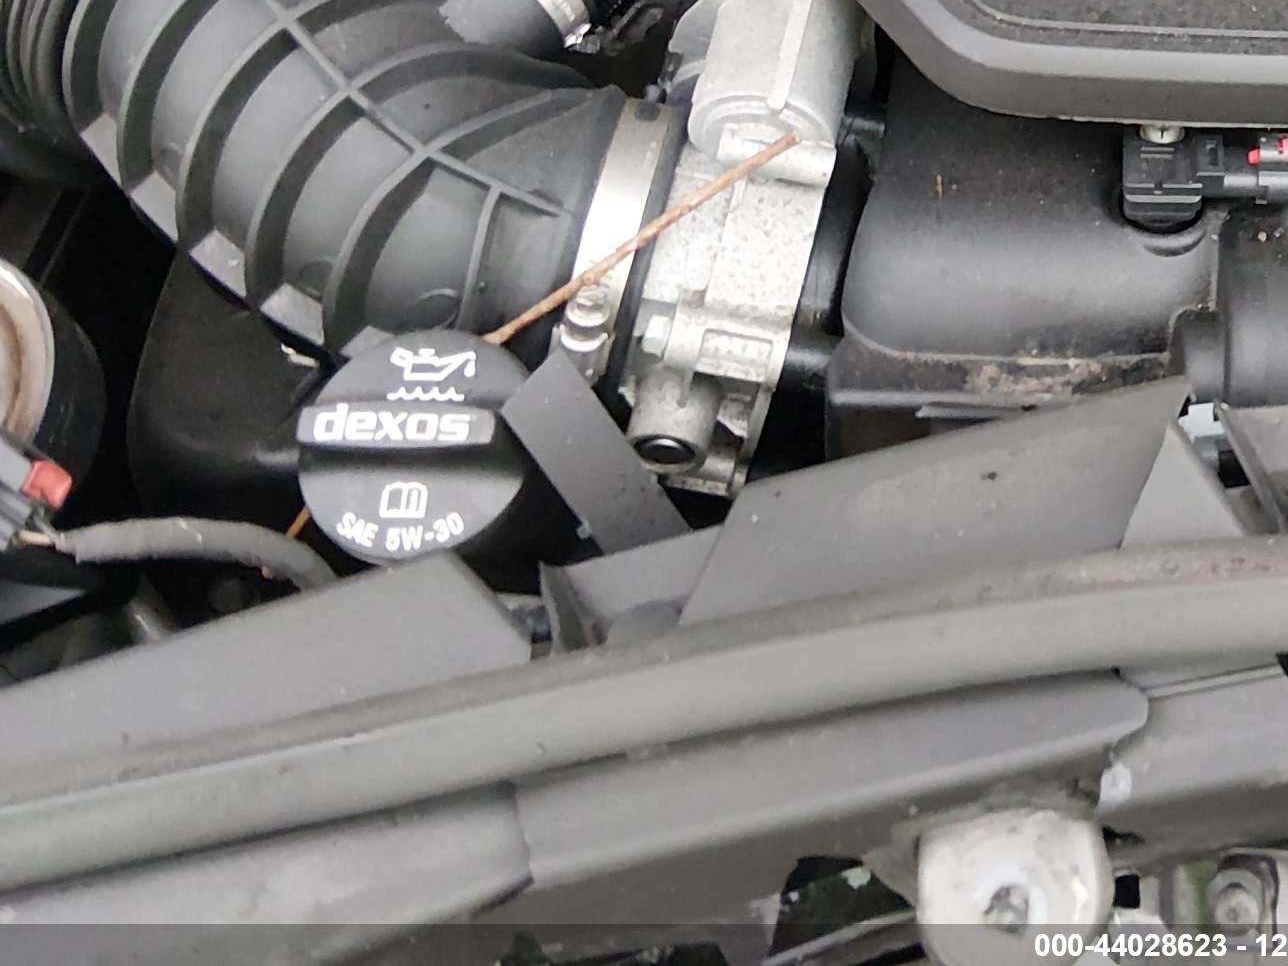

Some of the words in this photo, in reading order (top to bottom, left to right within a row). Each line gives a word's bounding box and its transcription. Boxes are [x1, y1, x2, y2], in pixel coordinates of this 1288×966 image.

[313, 403, 472, 443] dexos
[336, 512, 380, 547] SAE
[385, 511, 465, 552] 5W-30
